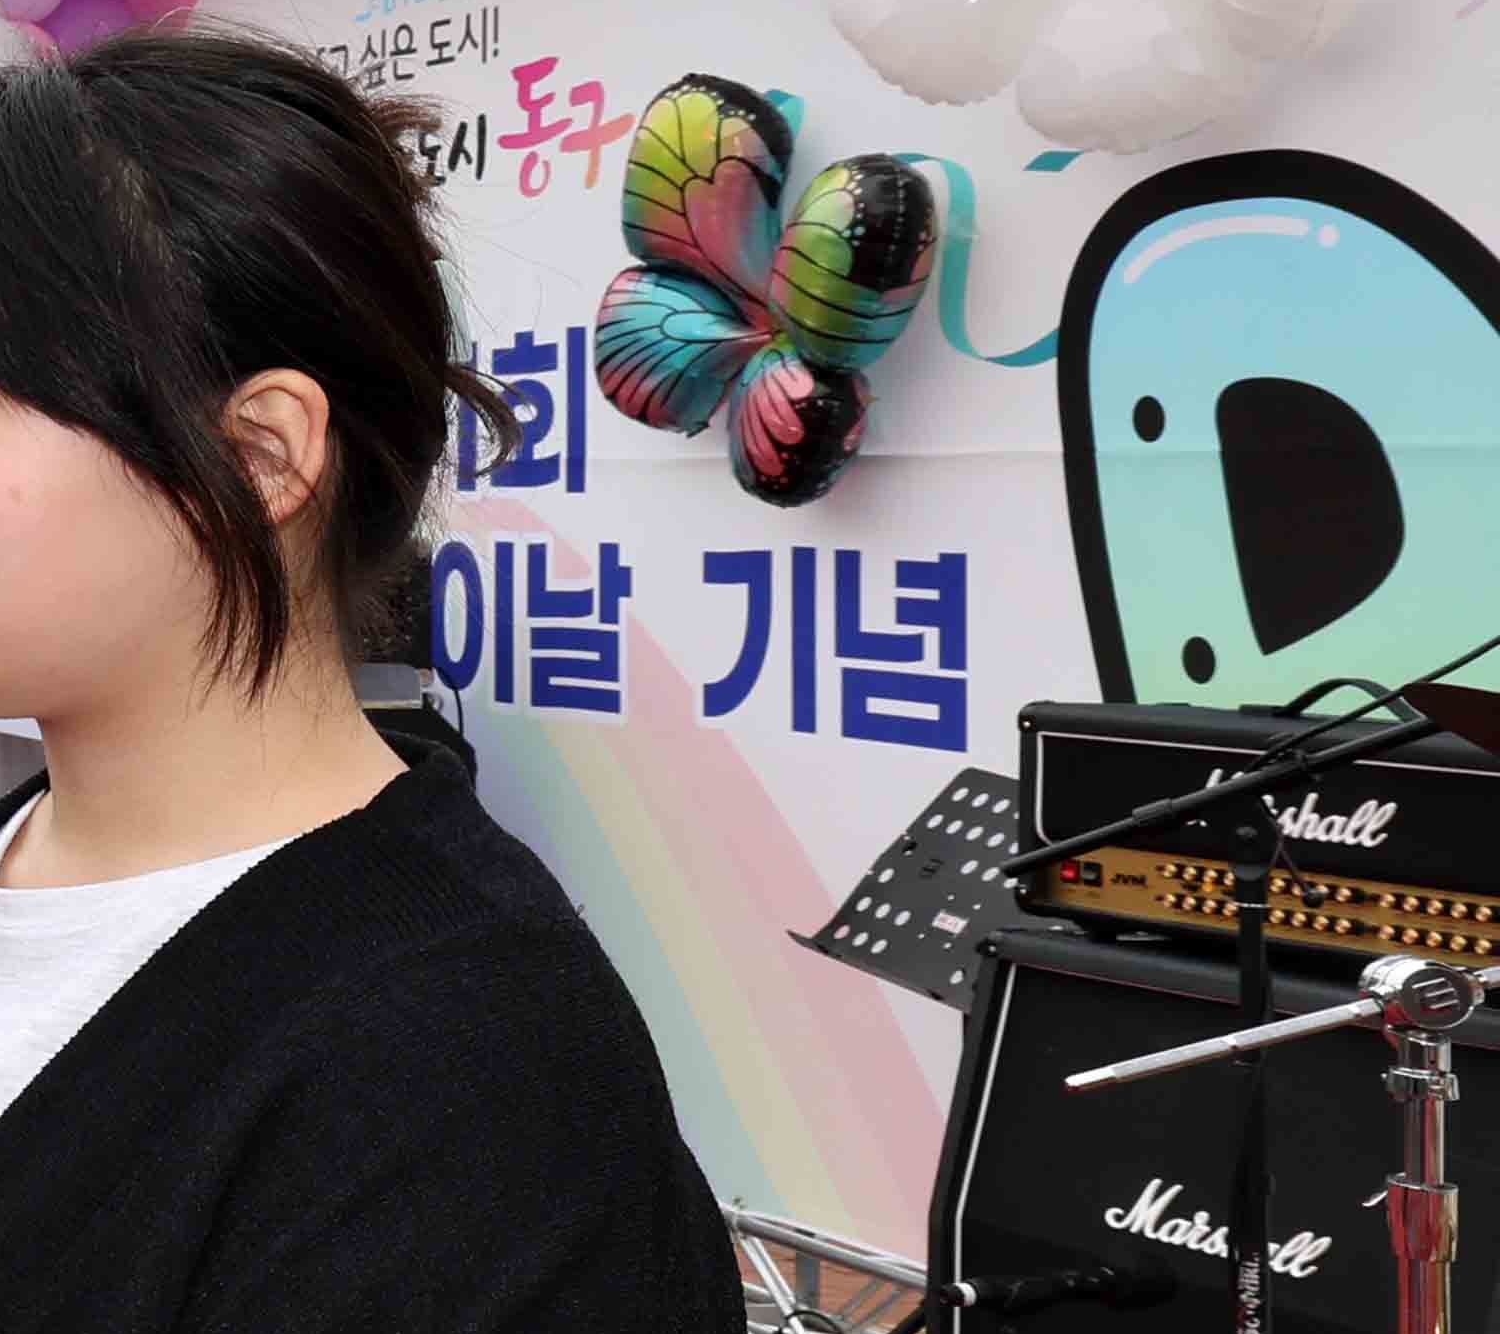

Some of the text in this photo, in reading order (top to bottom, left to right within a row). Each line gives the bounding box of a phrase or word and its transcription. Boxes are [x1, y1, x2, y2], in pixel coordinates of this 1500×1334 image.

[360, 23, 418, 89] 싶은
[426, 6, 501, 67] 도시!
[497, 56, 637, 198] 동구
[432, 540, 967, 752] 이날 기념
[1186, 768, 1398, 848] shall
[1104, 1178, 1333, 1278] Marsll
